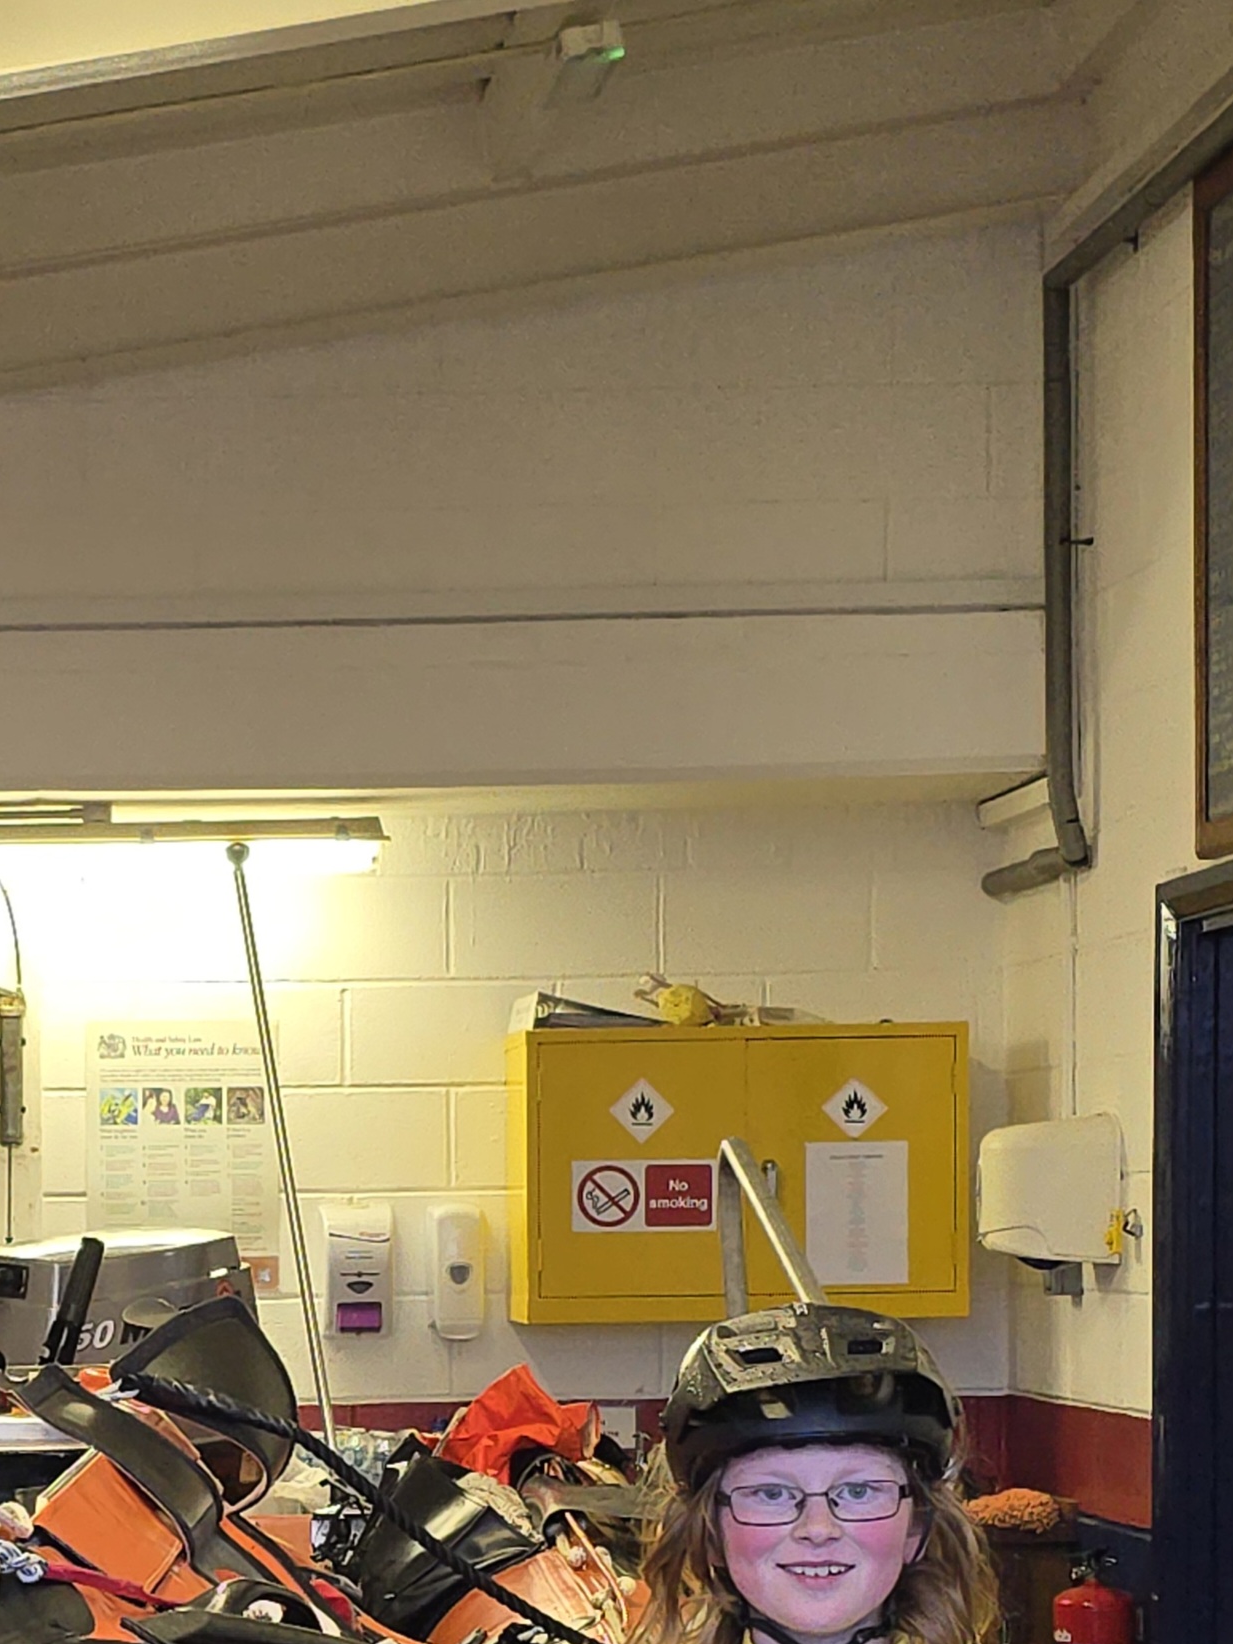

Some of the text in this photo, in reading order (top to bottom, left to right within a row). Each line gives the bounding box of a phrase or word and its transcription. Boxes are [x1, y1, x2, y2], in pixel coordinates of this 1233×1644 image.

[131, 1044, 163, 1056] What
[164, 1046, 186, 1059] you
[187, 1042, 215, 1056] need
[217, 1045, 229, 1056] to
[668, 1178, 689, 1192] No
[648, 1196, 709, 1212] smoking
